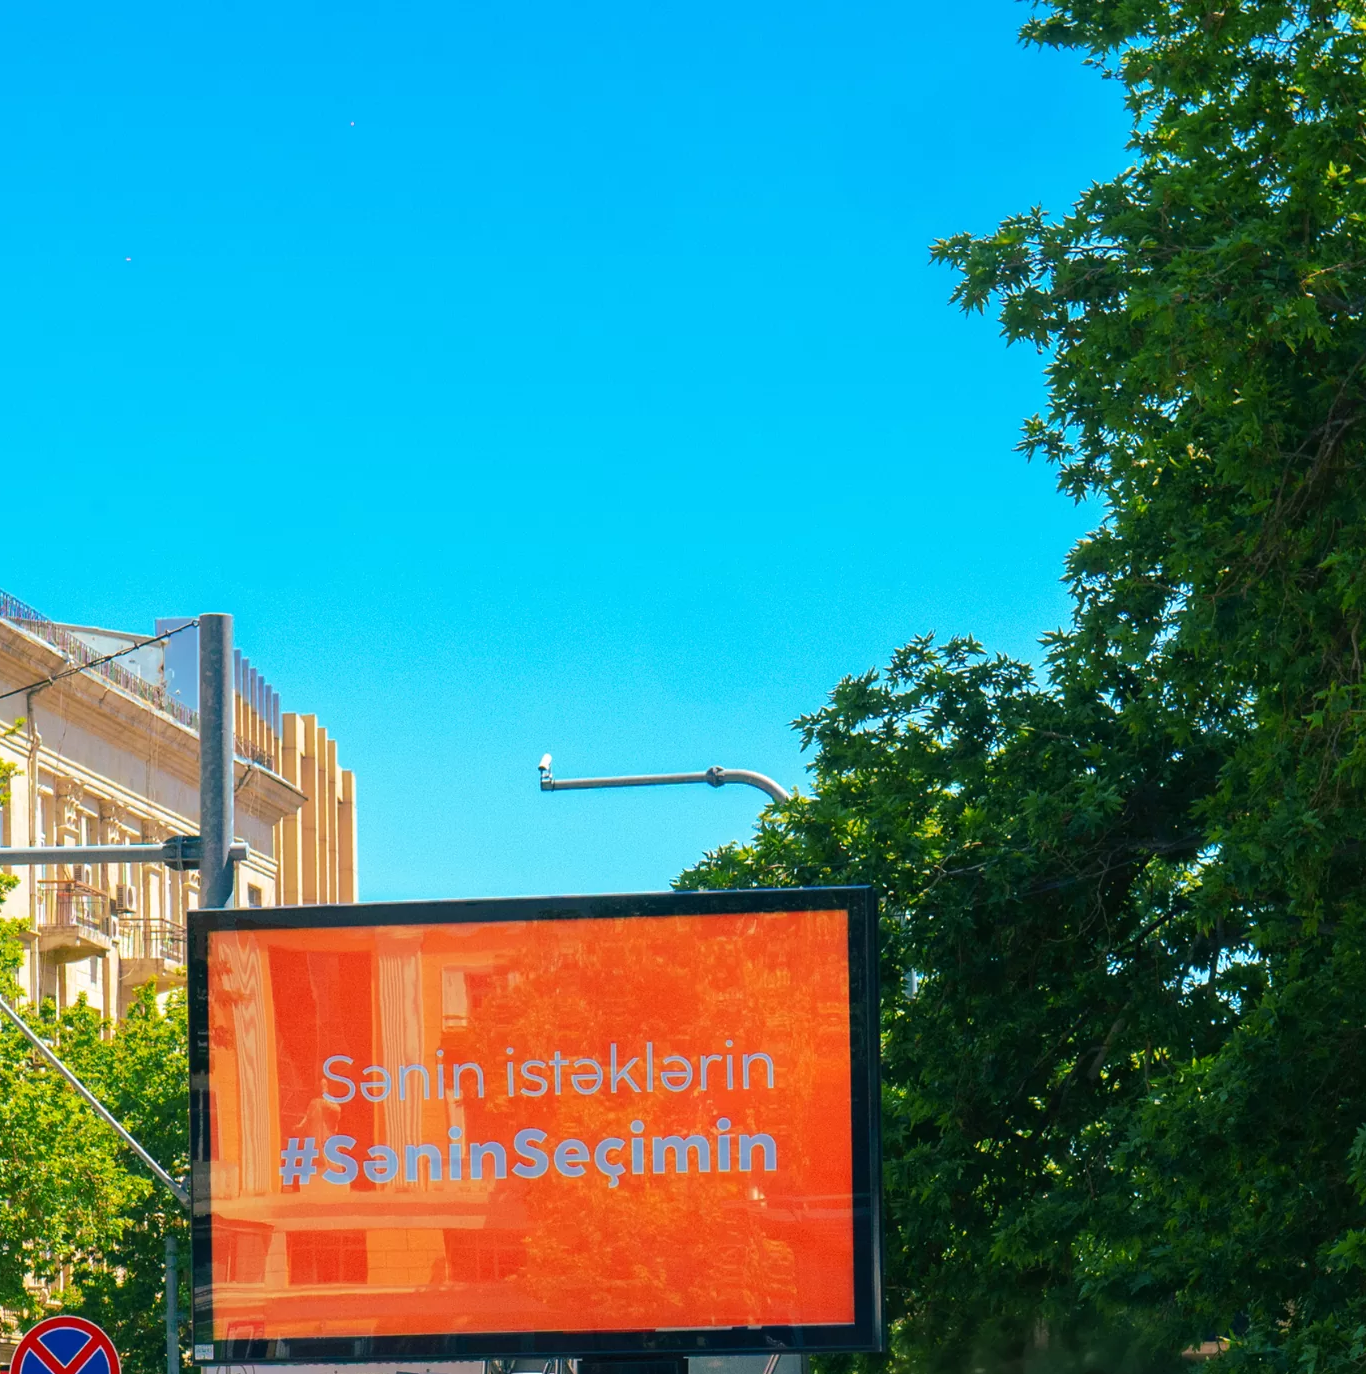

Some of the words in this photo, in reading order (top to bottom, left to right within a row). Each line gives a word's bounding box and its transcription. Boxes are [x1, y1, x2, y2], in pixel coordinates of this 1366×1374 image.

[322, 1049, 484, 1104] Sənin
[506, 1039, 775, 1099] istəklərin
[280, 1116, 778, 1188] #SəninSeçimin
